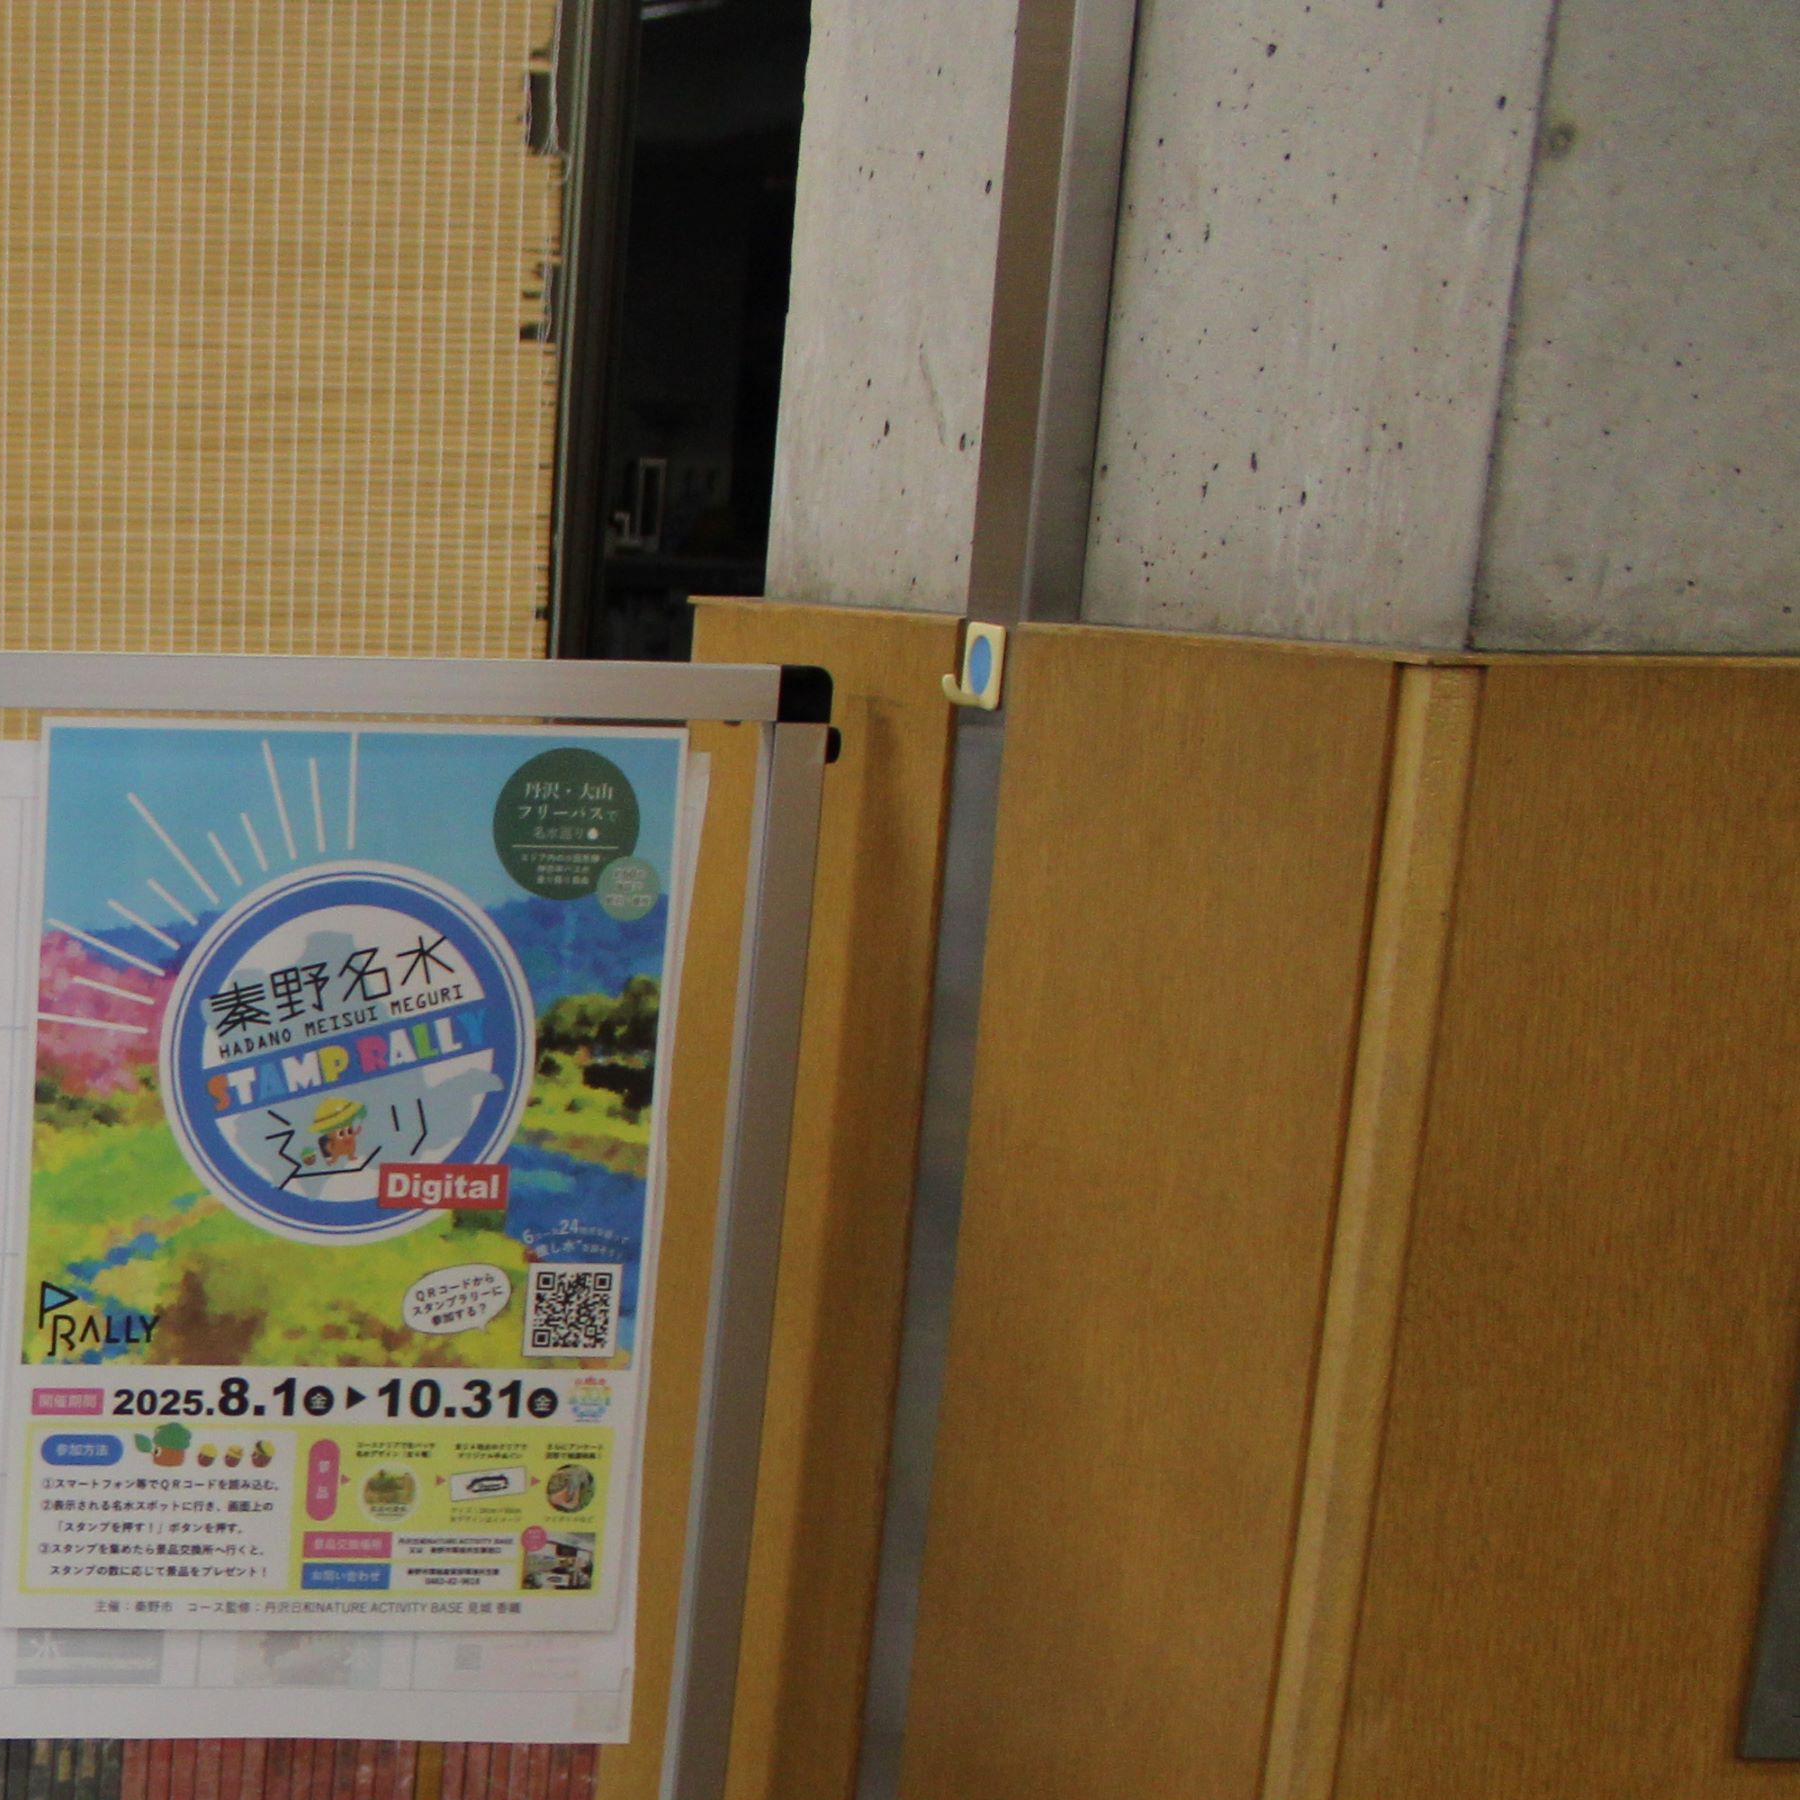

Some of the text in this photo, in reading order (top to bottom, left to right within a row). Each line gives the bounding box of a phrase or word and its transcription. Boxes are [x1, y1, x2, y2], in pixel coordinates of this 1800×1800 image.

[210, 935, 455, 1036] 秦野名水
[218, 984, 464, 1059] HADANO MEISUI MEGURI
[207, 1007, 488, 1111] STAMP RALLY
[386, 1170, 500, 1206] Digital
[112, 1377, 298, 1417] 2025.8.1
[378, 1378, 523, 1419] 10.31
